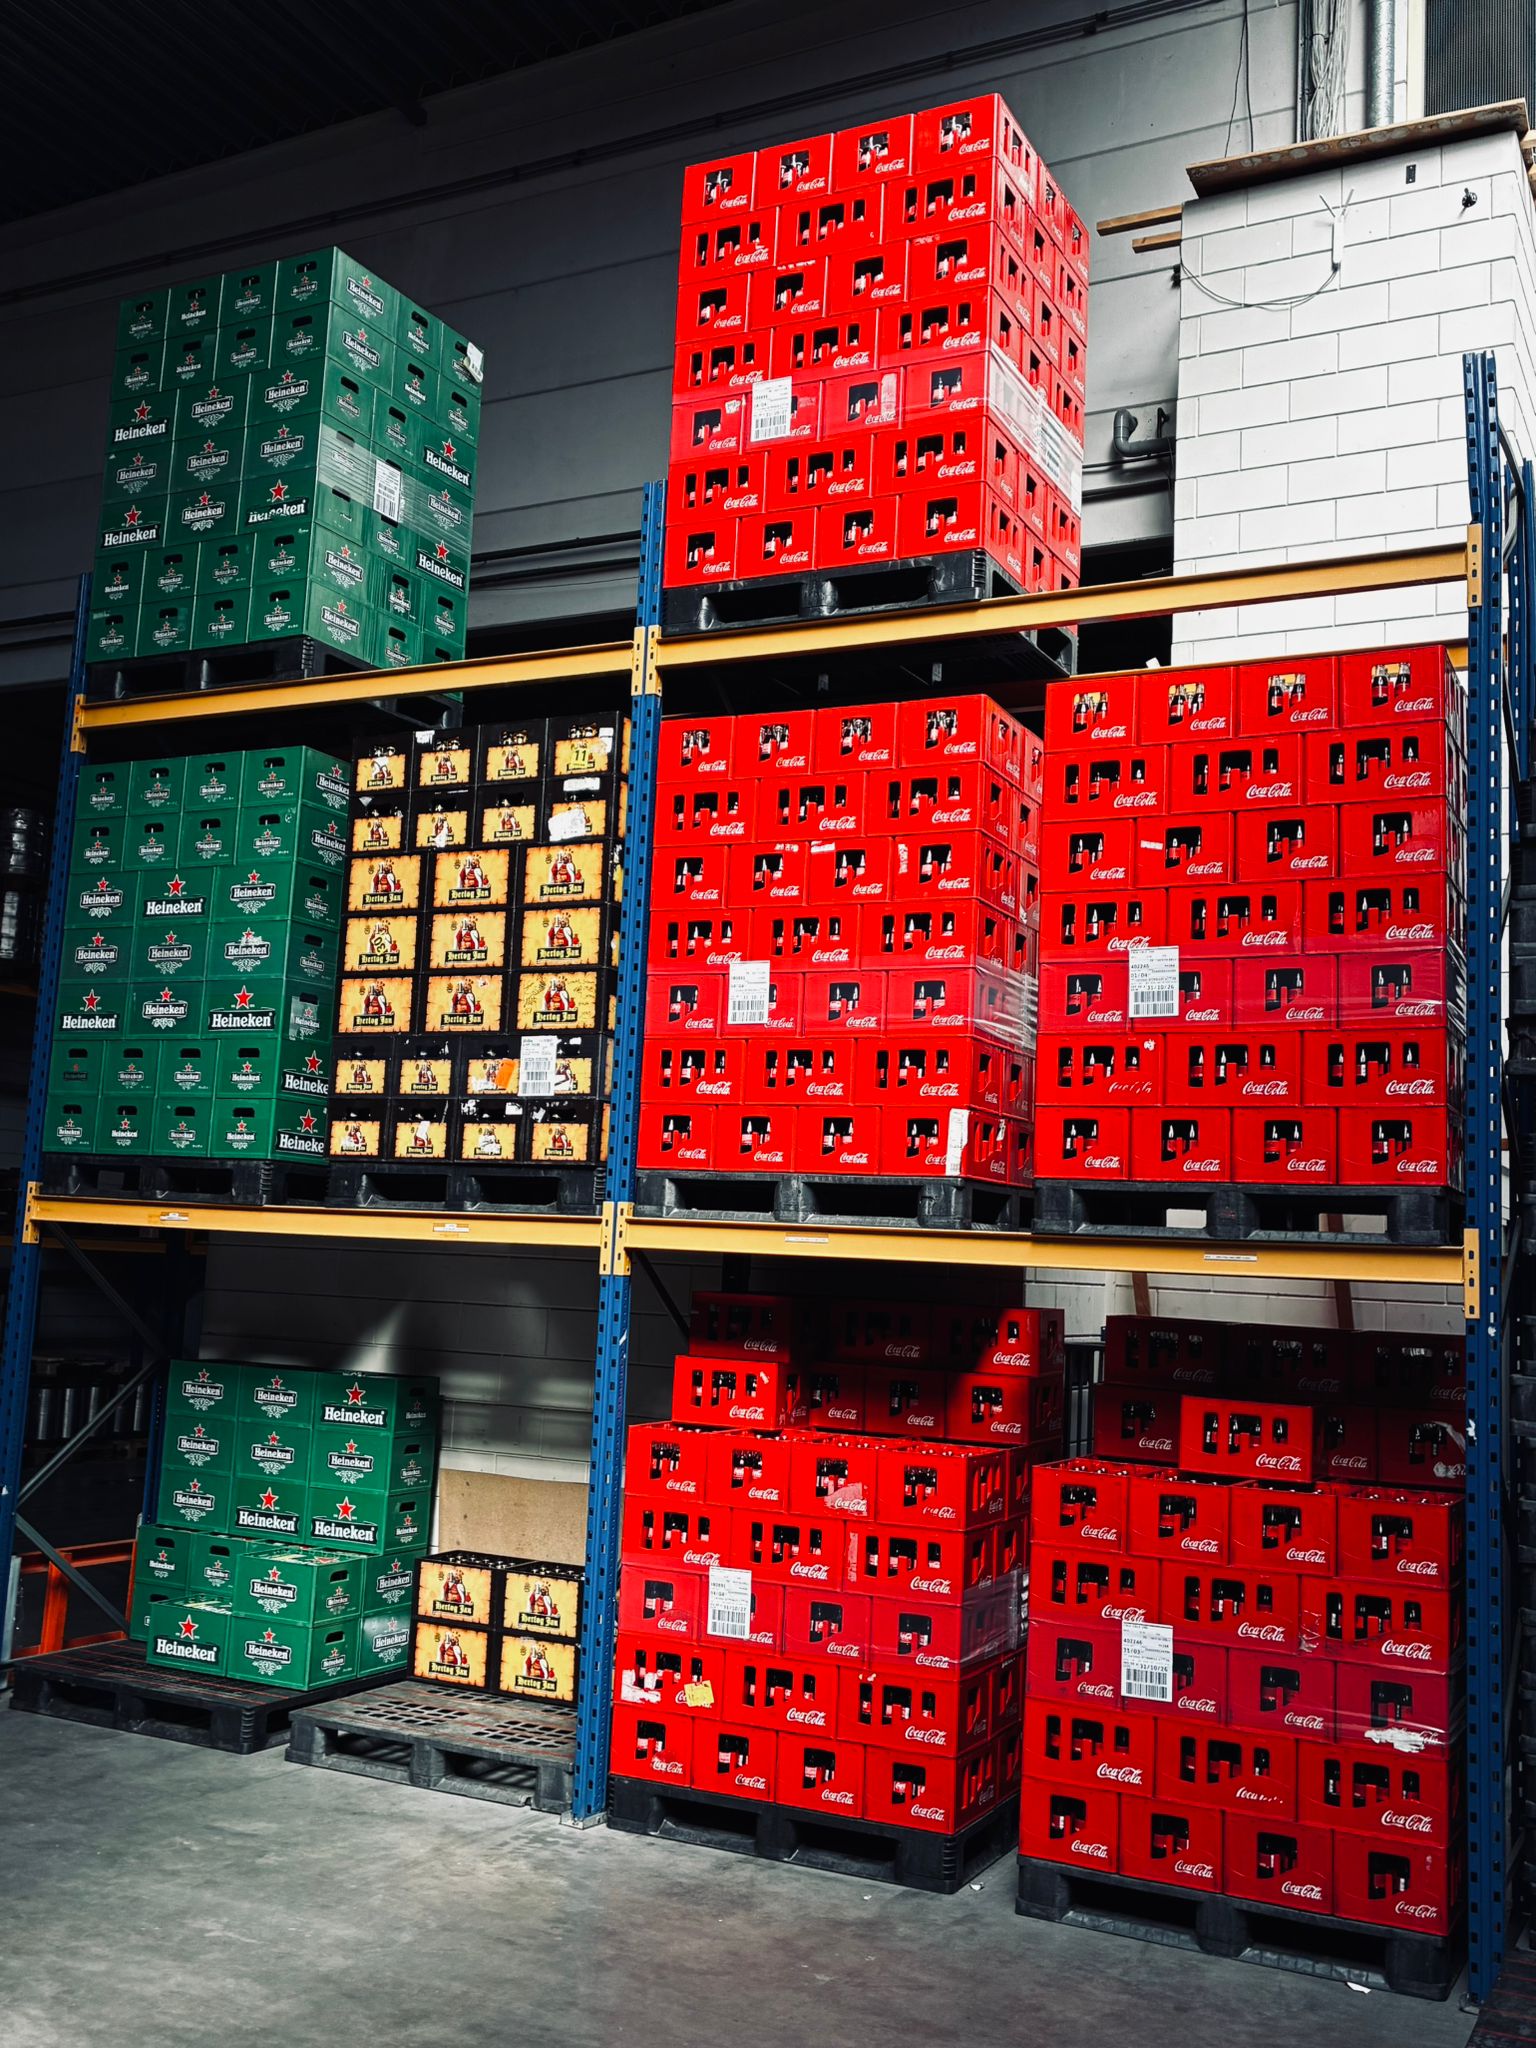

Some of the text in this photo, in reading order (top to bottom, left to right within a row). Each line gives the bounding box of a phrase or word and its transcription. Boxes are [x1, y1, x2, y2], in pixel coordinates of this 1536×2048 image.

[349, 281, 382, 310] Heineken
[344, 337, 378, 364] Heineken
[268, 383, 306, 398] Heineken
[194, 398, 231, 414] Heineken
[114, 422, 166, 441] Heineken
[263, 439, 301, 454] Heineken
[189, 455, 227, 469] Heineken
[426, 452, 469, 484] Heineken
[118, 465, 154, 480] Heineken
[184, 505, 223, 519] Heineken
[430, 497, 460, 521] Heineken
[104, 528, 158, 546] Heineken
[327, 555, 362, 579] Heineken
[420, 555, 463, 587] Heineken
[323, 610, 359, 634] Heineken
[575, 750, 586, 761] 11
[84, 893, 120, 905] Heineken
[234, 887, 271, 897] Heineken
[147, 901, 201, 915] Heineken
[78, 949, 114, 960] Heineken
[151, 947, 189, 958] Heineken
[229, 945, 267, 956] Heineken
[145, 1004, 183, 1015] Heineken
[63, 1015, 115, 1029] Heineken
[212, 1013, 271, 1027] Heineken
[185, 1384, 220, 1396] Heineken
[258, 1391, 294, 1404] Heineken
[324, 1407, 384, 1425] Heineken
[180, 1440, 216, 1454] Heineken
[254, 1448, 291, 1460] Heineken
[331, 1456, 370, 1469] Heineken
[176, 1495, 212, 1508] Heineken
[239, 1512, 295, 1530] Heineken
[315, 1521, 374, 1542] Heineken
[379, 1573, 411, 1587] Heineken
[253, 1583, 292, 1597] Heineken
[375, 1632, 407, 1648] Heineken
[156, 1639, 216, 1661] Heineken
[248, 1646, 288, 1659] Heineken
